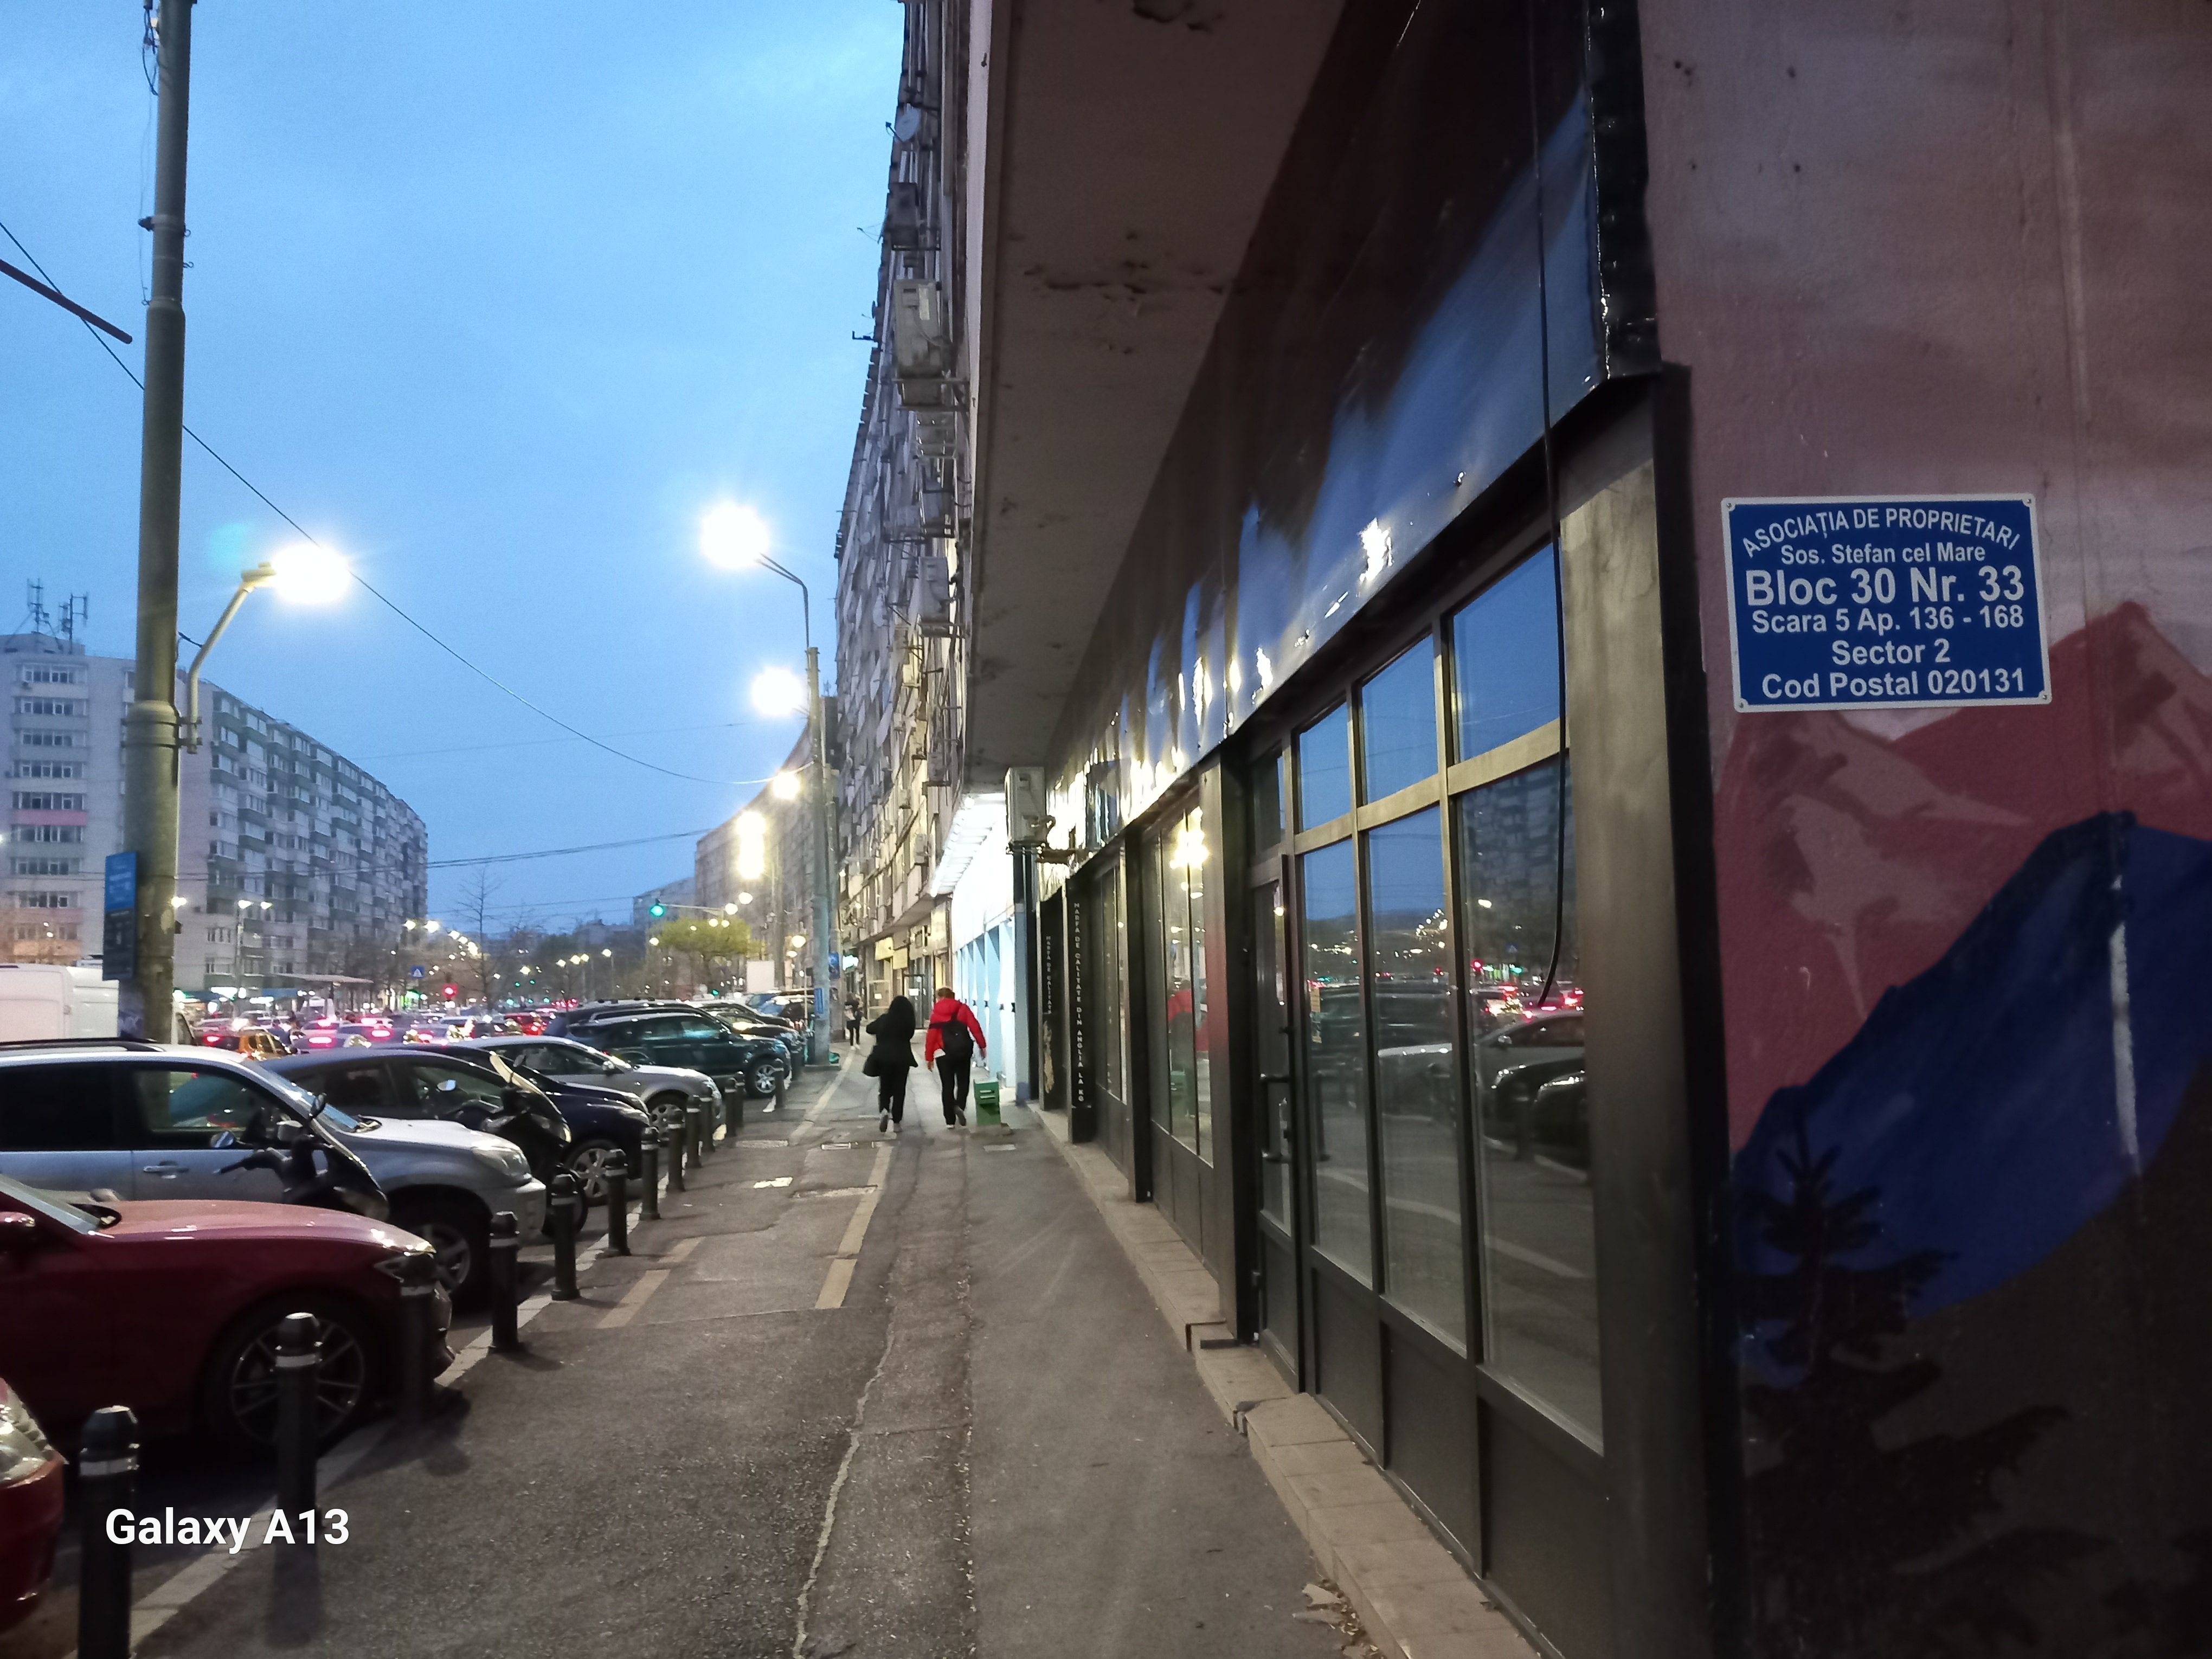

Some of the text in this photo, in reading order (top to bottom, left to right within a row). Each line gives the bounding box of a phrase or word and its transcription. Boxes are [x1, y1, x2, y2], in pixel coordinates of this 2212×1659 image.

[1854, 509, 1880, 528] DE
[1887, 508, 2021, 550] PROPRIETARI
[1781, 542, 1986, 565] Sos. Stefan cel Mare
[1746, 565, 2024, 606] Bloc 30 Nr. 33
[1752, 610, 1827, 634] Scara
[1836, 609, 1849, 632] 5
[1858, 608, 1900, 635] Ap.
[1910, 606, 1954, 630] 136
[1979, 605, 2024, 628] 168
[1832, 639, 1951, 666] Sector 2
[1762, 668, 2024, 699] Cod Postal 020131
